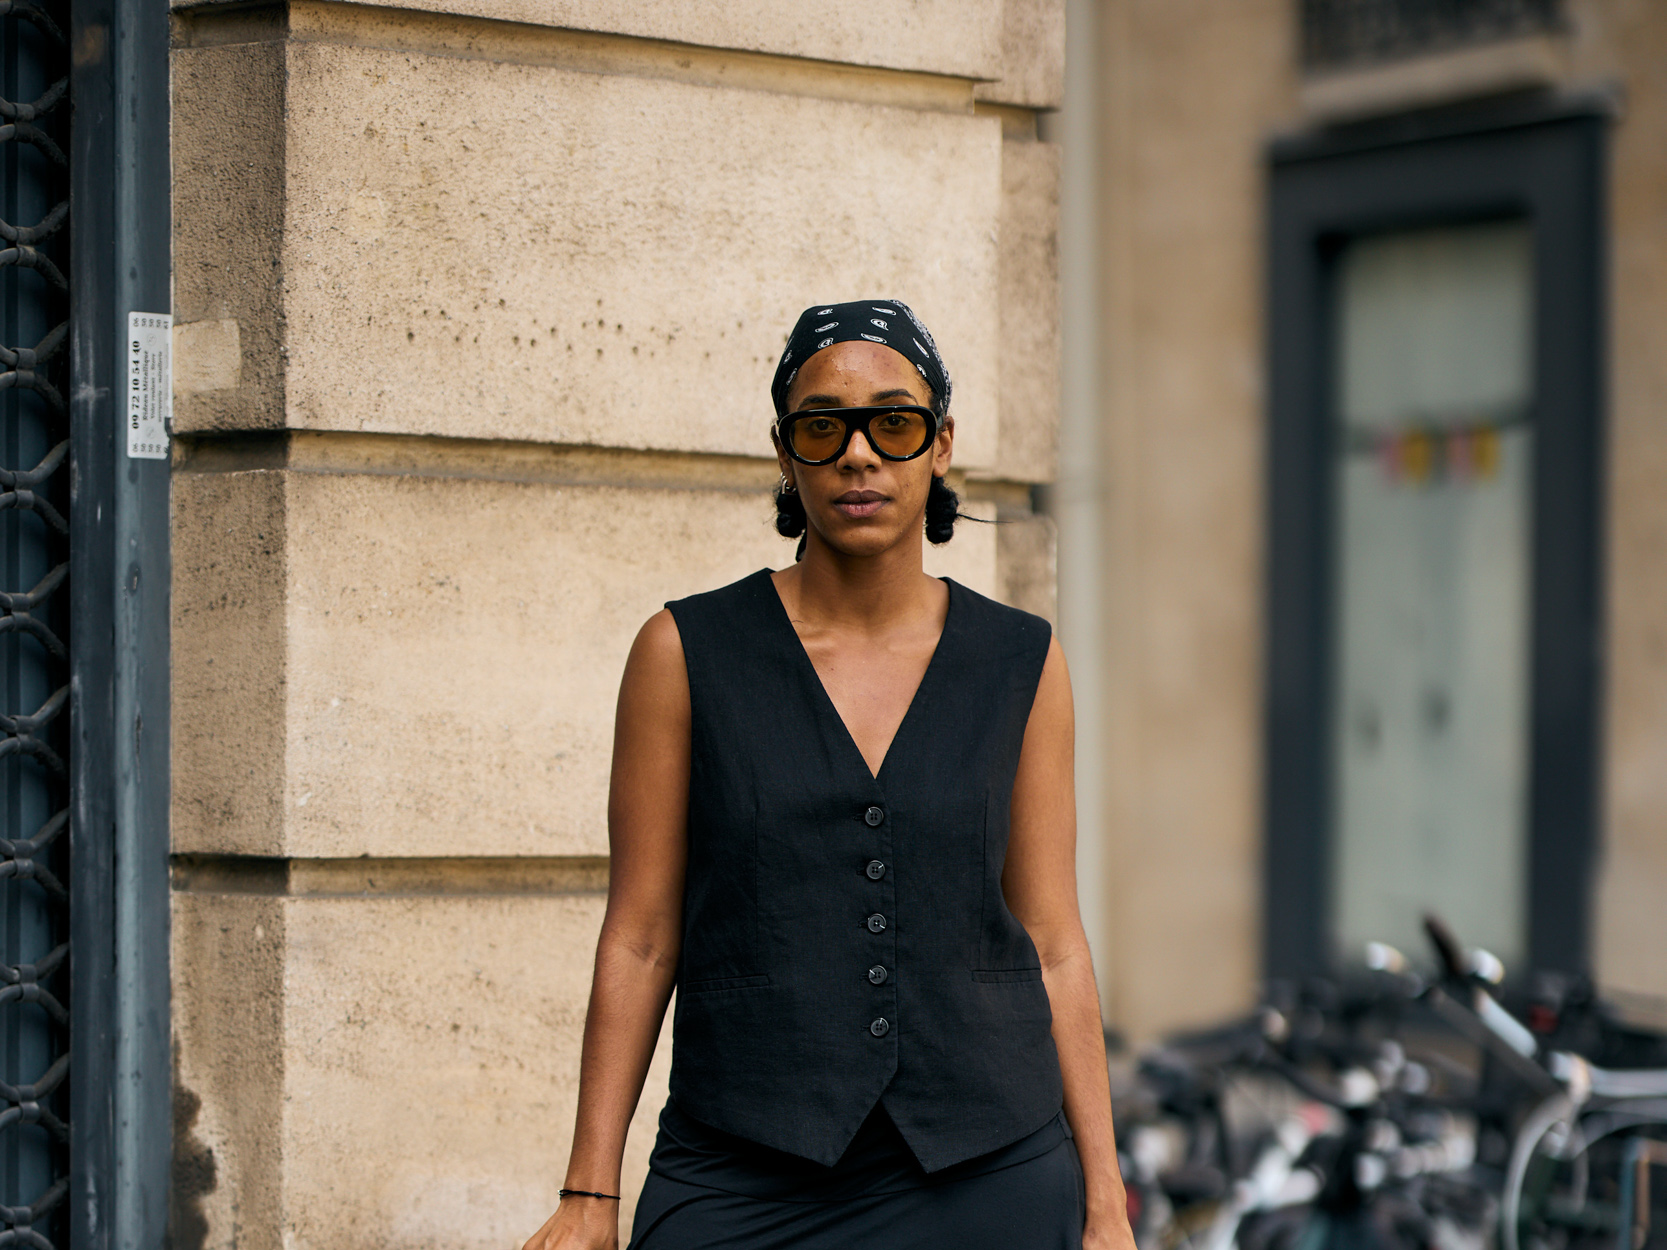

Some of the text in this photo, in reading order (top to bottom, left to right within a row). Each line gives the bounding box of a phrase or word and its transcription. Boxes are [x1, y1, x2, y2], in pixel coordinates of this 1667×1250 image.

[131, 340, 142, 429] 09 72 10 54 40
[142, 350, 151, 392] Métallique
